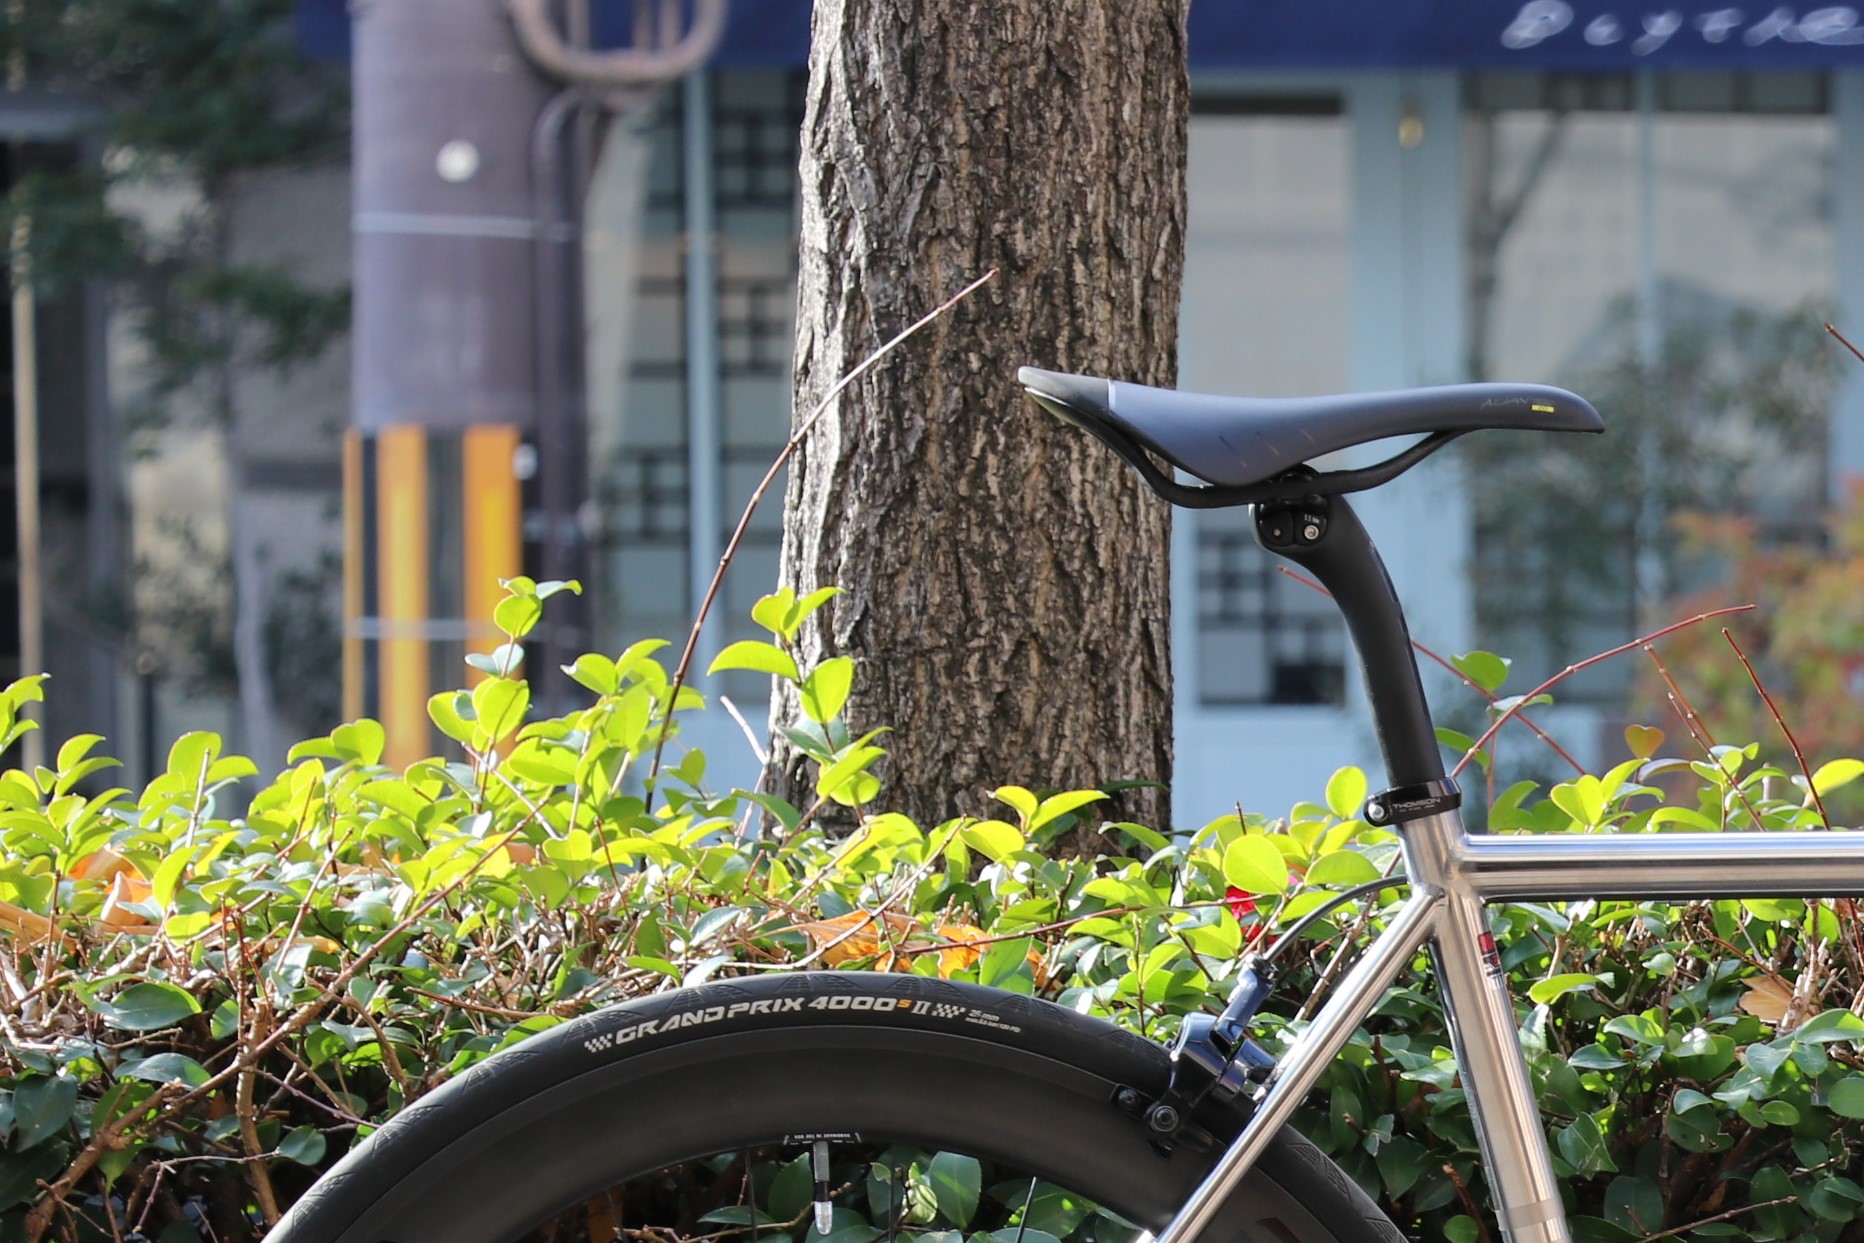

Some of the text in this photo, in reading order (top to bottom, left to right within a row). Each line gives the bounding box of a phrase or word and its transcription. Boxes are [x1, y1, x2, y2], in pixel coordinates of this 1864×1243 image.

[1392, 797, 1440, 810] THOMSON
[615, 1007, 727, 1045] GRAND
[727, 996, 803, 1020] PRIX
